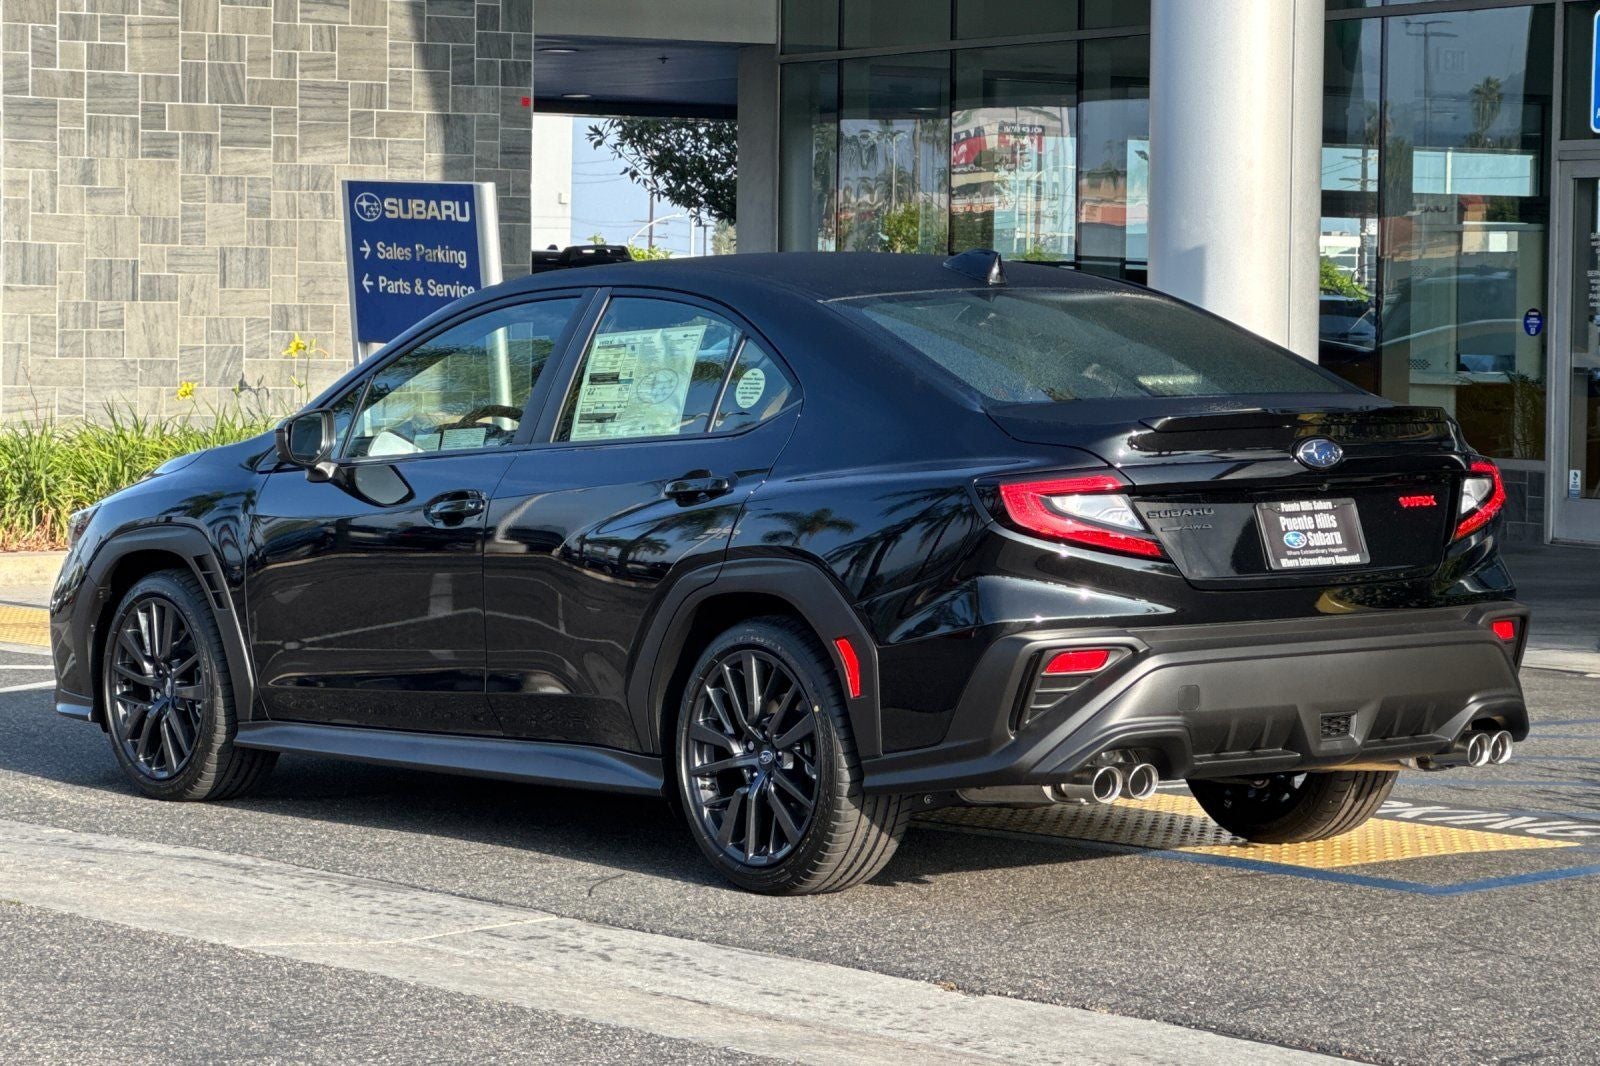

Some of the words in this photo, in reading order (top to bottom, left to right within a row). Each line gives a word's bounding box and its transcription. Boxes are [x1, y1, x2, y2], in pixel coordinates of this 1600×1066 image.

[384, 197, 471, 222] SUBARU
[376, 241, 412, 261] Sales
[415, 243, 467, 269] Parking
[378, 275, 411, 295] Parts
[414, 278, 425, 296] &
[427, 279, 475, 298] Service
[1398, 494, 1438, 508] WRX
[1146, 507, 1215, 519] SUBARU
[1279, 515, 1315, 532] Puente
[1314, 513, 1338, 529] Hills
[1306, 530, 1343, 547] Subaru
